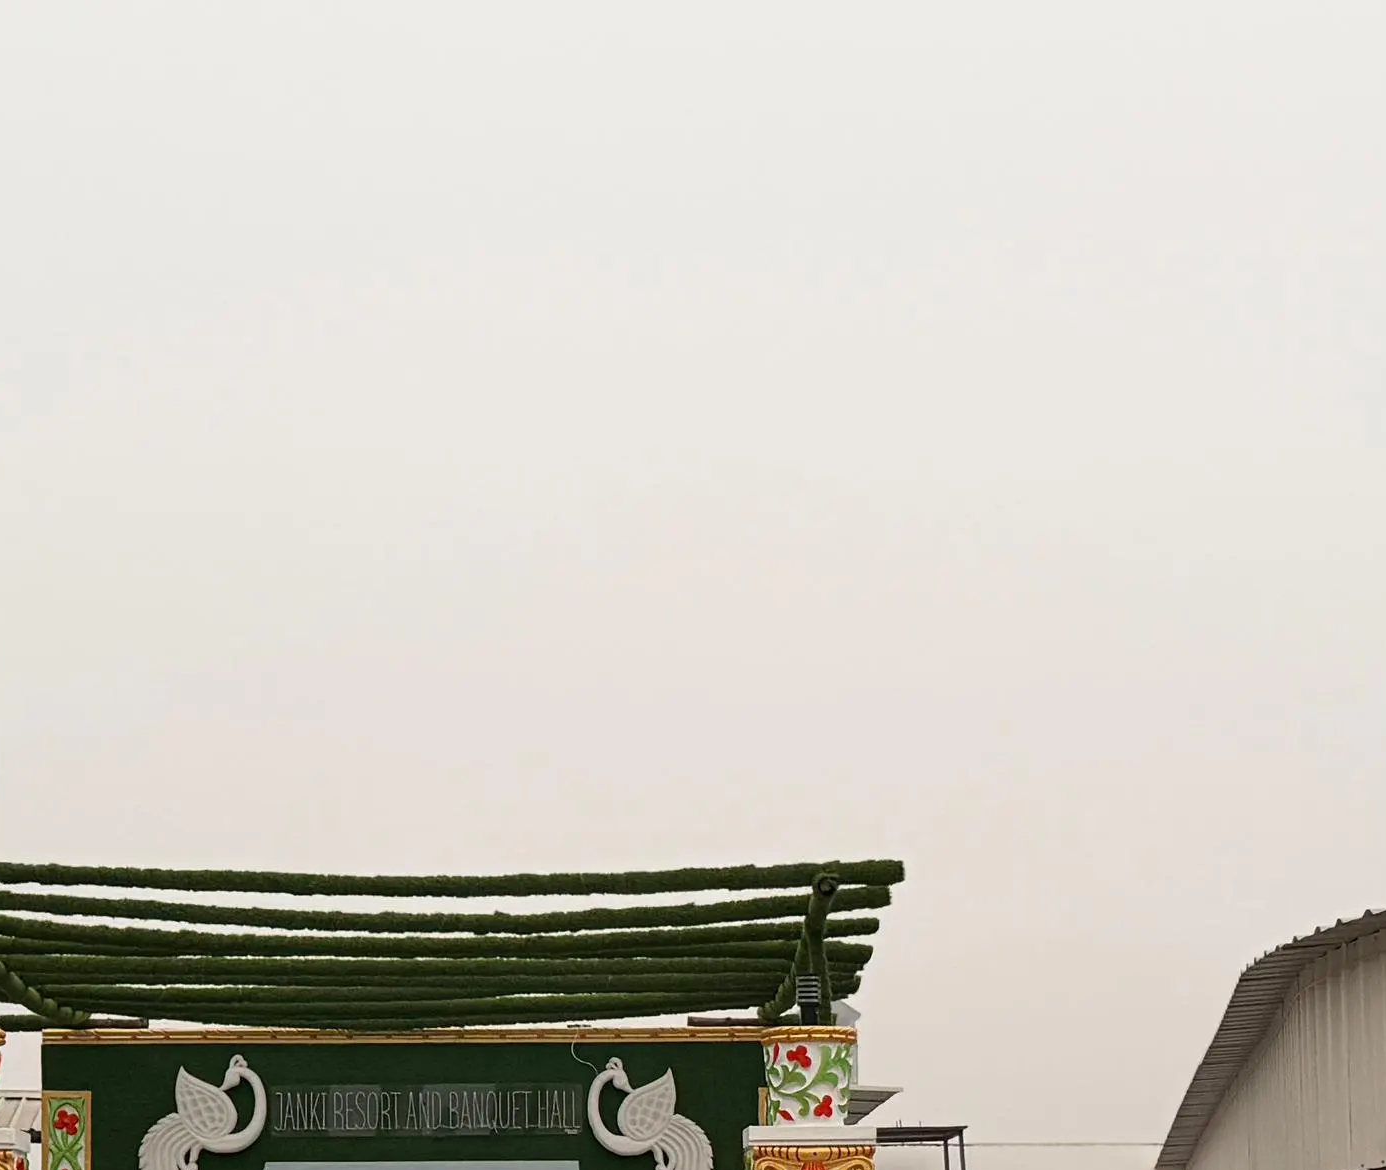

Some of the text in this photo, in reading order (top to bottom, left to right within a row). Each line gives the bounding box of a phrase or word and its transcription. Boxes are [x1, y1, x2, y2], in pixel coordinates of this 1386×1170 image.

[274, 1089, 582, 1134] JANKI RESORT AND BANQUET HALL
